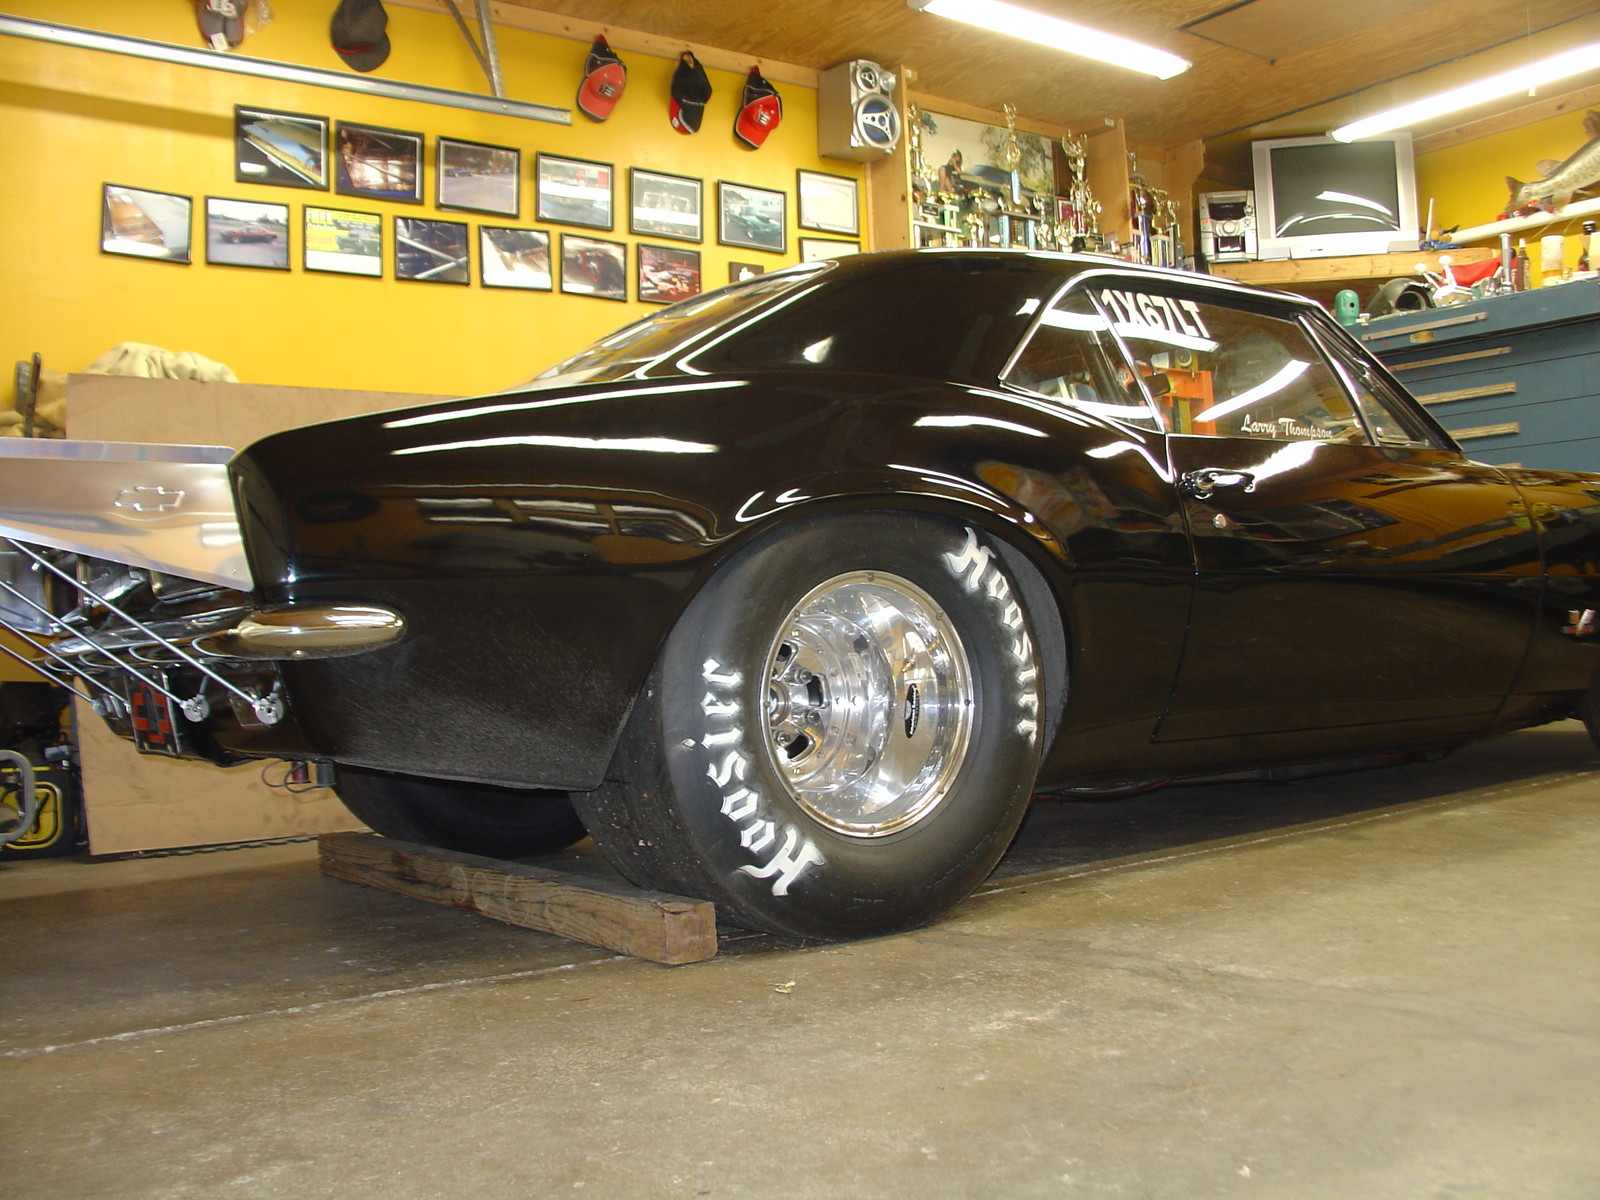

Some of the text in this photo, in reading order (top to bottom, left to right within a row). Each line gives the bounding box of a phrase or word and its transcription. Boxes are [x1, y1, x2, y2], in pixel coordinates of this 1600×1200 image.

[1101, 289, 1210, 338] 1X67LT
[1241, 414, 1333, 440] Larry Thompson
